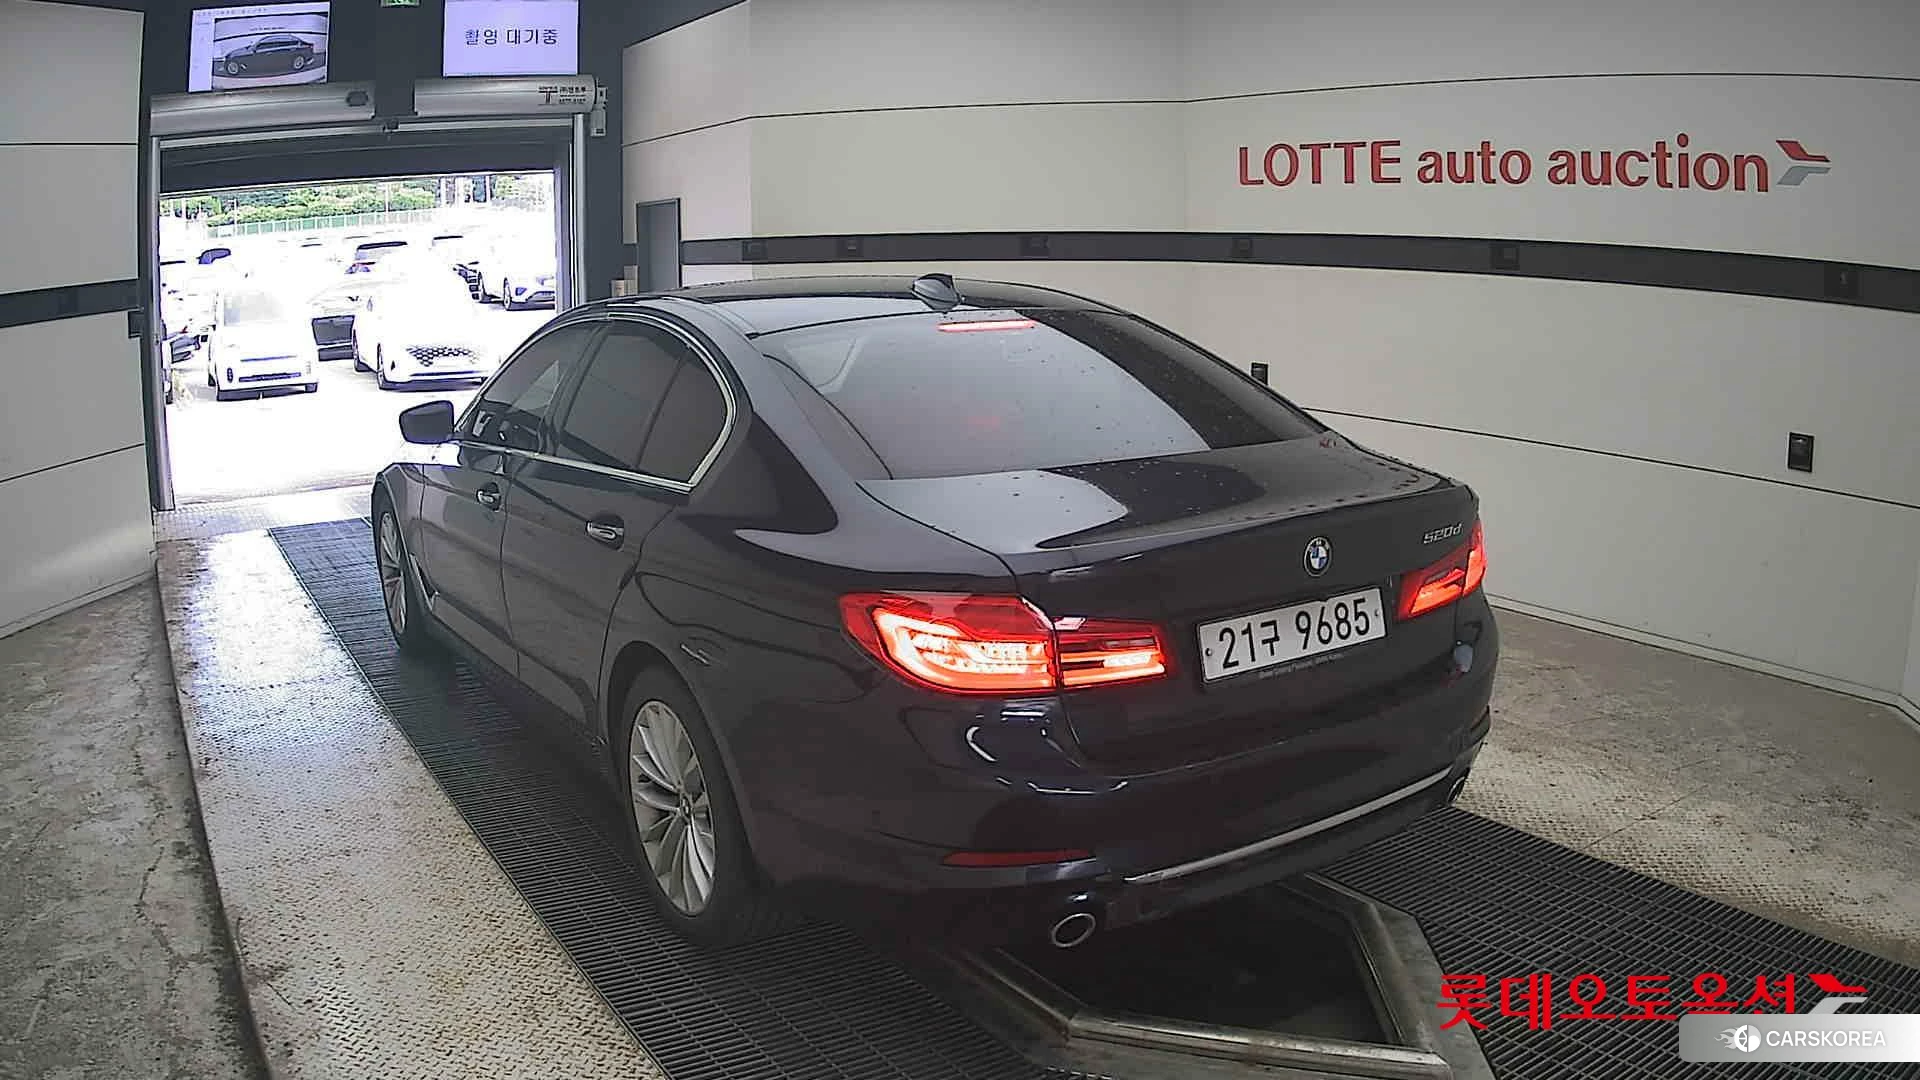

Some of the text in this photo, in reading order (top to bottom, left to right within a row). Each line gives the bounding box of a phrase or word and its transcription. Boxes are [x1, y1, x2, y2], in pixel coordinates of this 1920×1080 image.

[506, 28, 559, 45] 대기중
[1238, 133, 1768, 192] LOTTE auto auction
[1423, 523, 1462, 544] 520d
[1218, 619, 1280, 669] 21구
[1295, 597, 1370, 651] 9685
